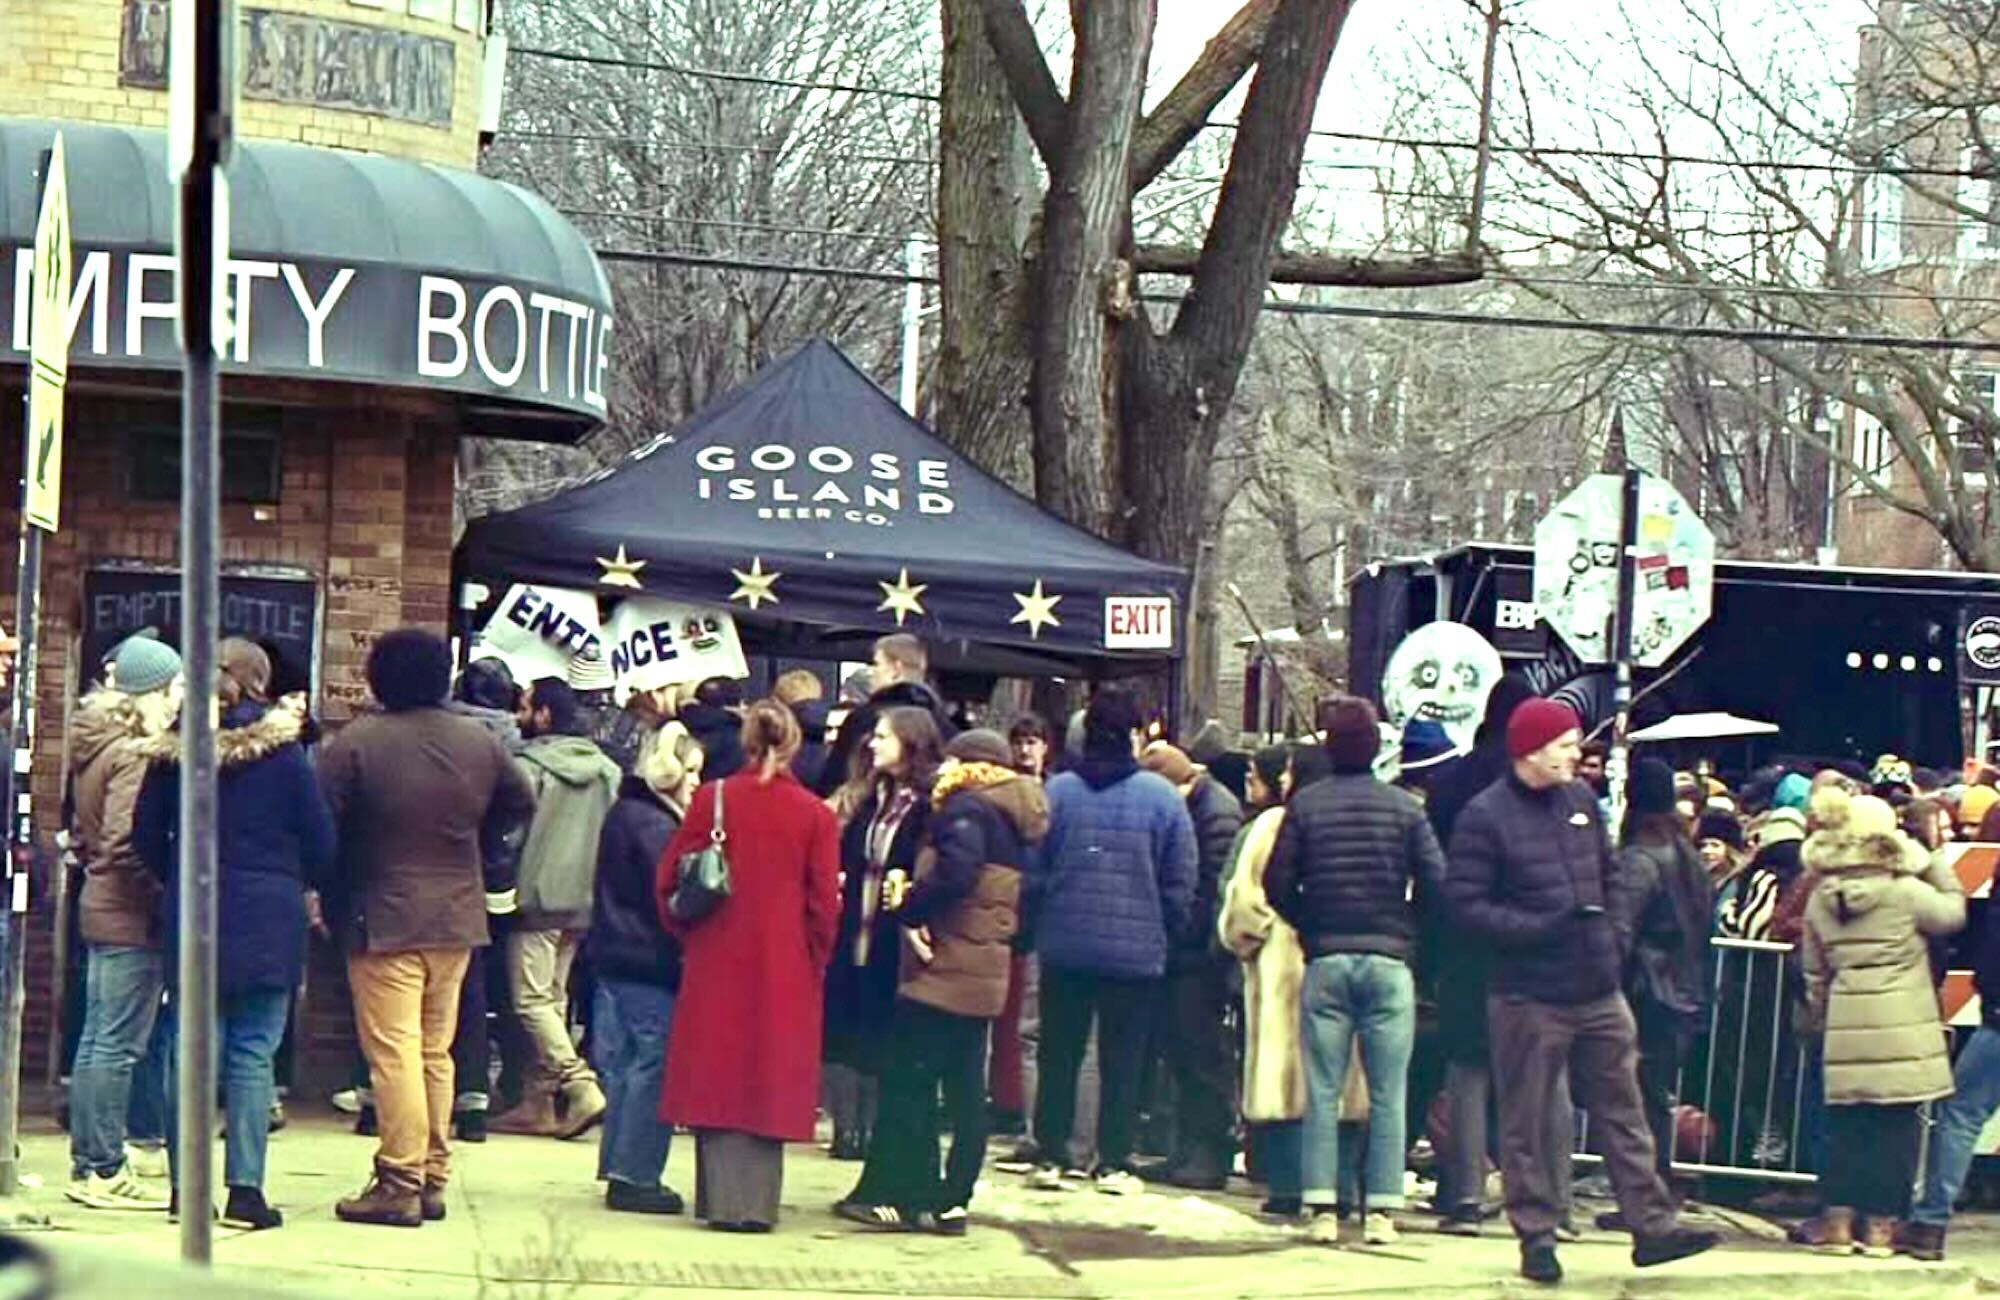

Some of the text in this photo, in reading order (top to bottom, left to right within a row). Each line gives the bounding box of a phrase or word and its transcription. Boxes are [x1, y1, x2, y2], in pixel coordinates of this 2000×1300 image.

[417, 275, 612, 410] BOTTLE
[696, 444, 949, 488] GOOSE
[699, 478, 955, 514] ISLAND
[757, 507, 832, 519] BEER
[94, 591, 306, 639] EMPT OTTLE
[1111, 604, 1166, 635] EXIT
